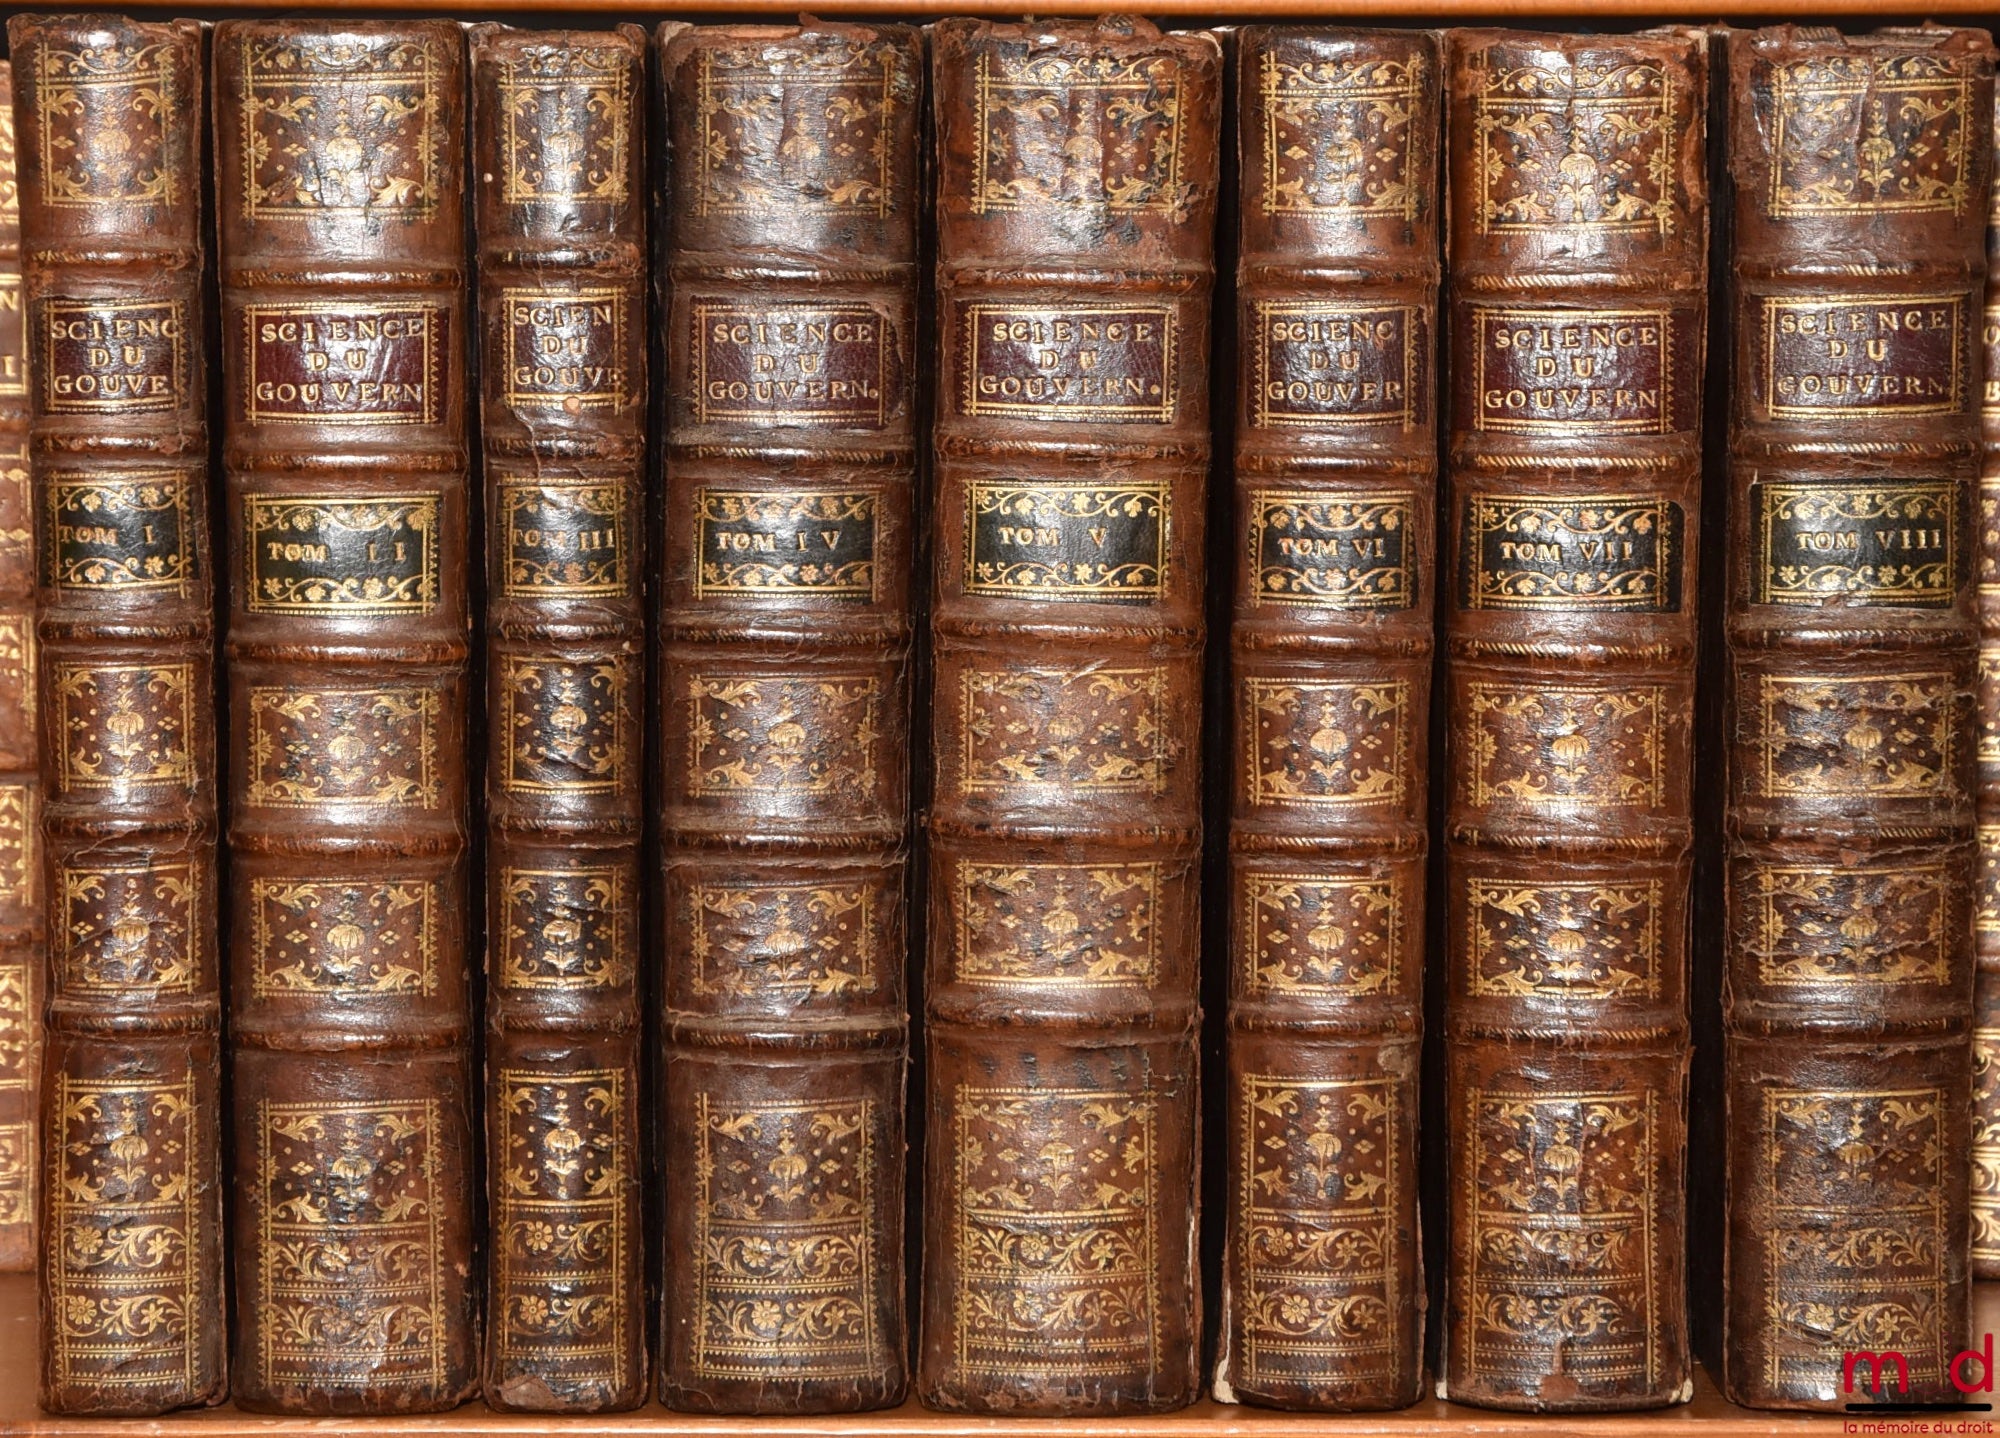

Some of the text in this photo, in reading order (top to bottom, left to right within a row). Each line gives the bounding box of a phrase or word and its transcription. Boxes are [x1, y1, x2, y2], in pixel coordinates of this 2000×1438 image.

[514, 305, 612, 327] SCIEN
[1780, 310, 1947, 335] SCIENCE
[51, 318, 180, 340] SCIENC
[261, 318, 424, 343] SCIENCE
[713, 323, 873, 344] SCIENCE
[992, 322, 1152, 343] SCIENCE
[1272, 320, 1394, 342] SCIENC
[1495, 327, 1658, 349] SCIENCE
[54, 374, 169, 395] GOUVE
[256, 381, 422, 404] GOUVERN
[708, 380, 879, 405] GOUVERN.
[979, 375, 1161, 397] GOUVERN.
[1267, 381, 1404, 402] GOUVER
[1485, 389, 1657, 410] GOUVERN
[58, 525, 155, 546] TOM I
[512, 528, 566, 549] TOM
[715, 532, 776, 552] TOM
[997, 527, 1059, 547] TOM
[1795, 531, 1858, 550] TOM
[266, 541, 329, 563] TOM
[1277, 537, 1339, 557] TOM
[1500, 541, 1562, 563] TOM
